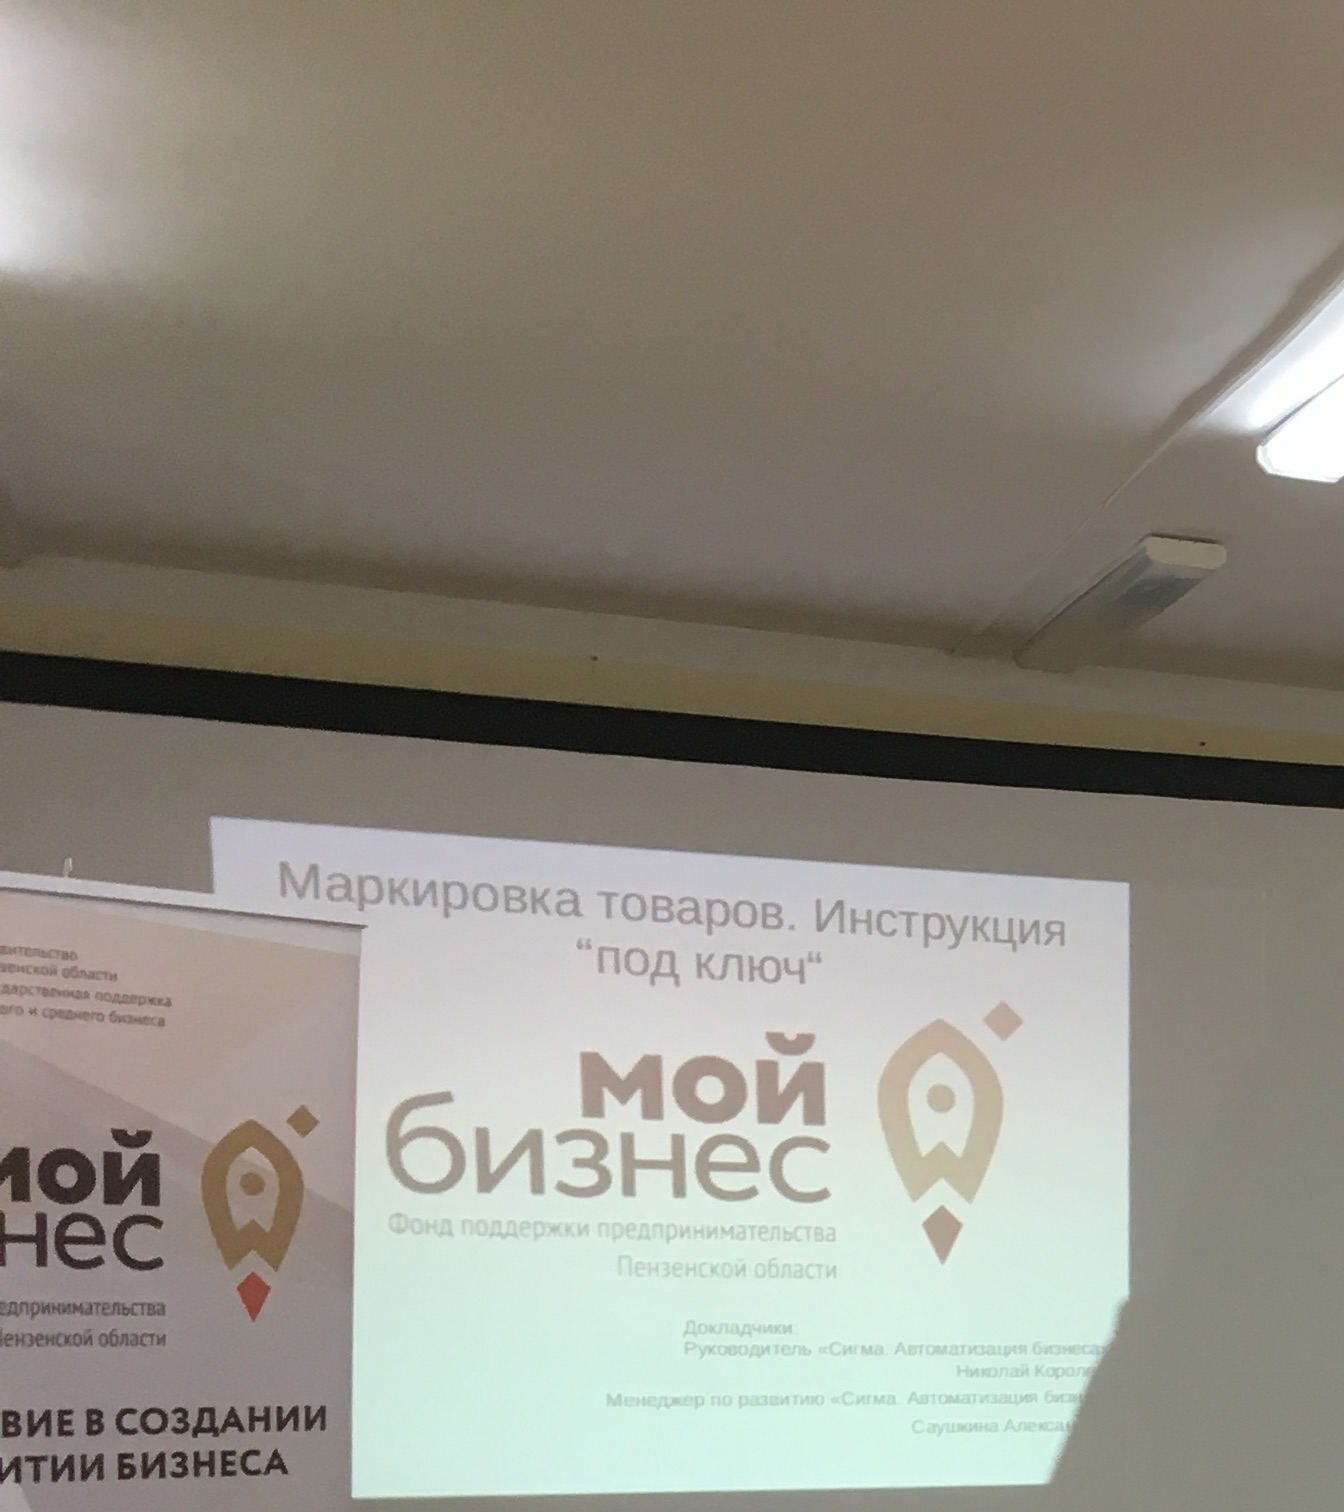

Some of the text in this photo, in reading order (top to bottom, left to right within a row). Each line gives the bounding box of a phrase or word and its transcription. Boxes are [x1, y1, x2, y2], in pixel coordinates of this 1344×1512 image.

[278, 860, 1067, 951] Маркировка товаров. Инструкция
[61, 965, 118, 982] области
[94, 990, 173, 1008] поддержка
[28, 1006, 38, 1016] и
[42, 1007, 106, 1024] среднего
[109, 1009, 166, 1028] бизнеса
[579, 1030, 827, 1127] мой
[385, 1090, 832, 1204] бизнес
[387, 1211, 838, 1244] Фонд поддержки предпринимательства
[616, 1254, 838, 1281] Пензенской области
[98, 1327, 167, 1348] области
[683, 1340, 813, 1359] Руководитель
[894, 1341, 1028, 1359] Автоматизация
[956, 1362, 1031, 1379] Николай
[605, 1392, 706, 1411] Менеджер
[710, 1394, 734, 1408] по
[738, 1393, 826, 1411] развитию
[906, 1390, 1038, 1406] Автоматизация
[2, 1404, 328, 1438] ВИЕ В СОЗДАНИИ
[911, 1418, 999, 1437] Саушкина
[117, 1448, 289, 1480] БИЗНЕСА
